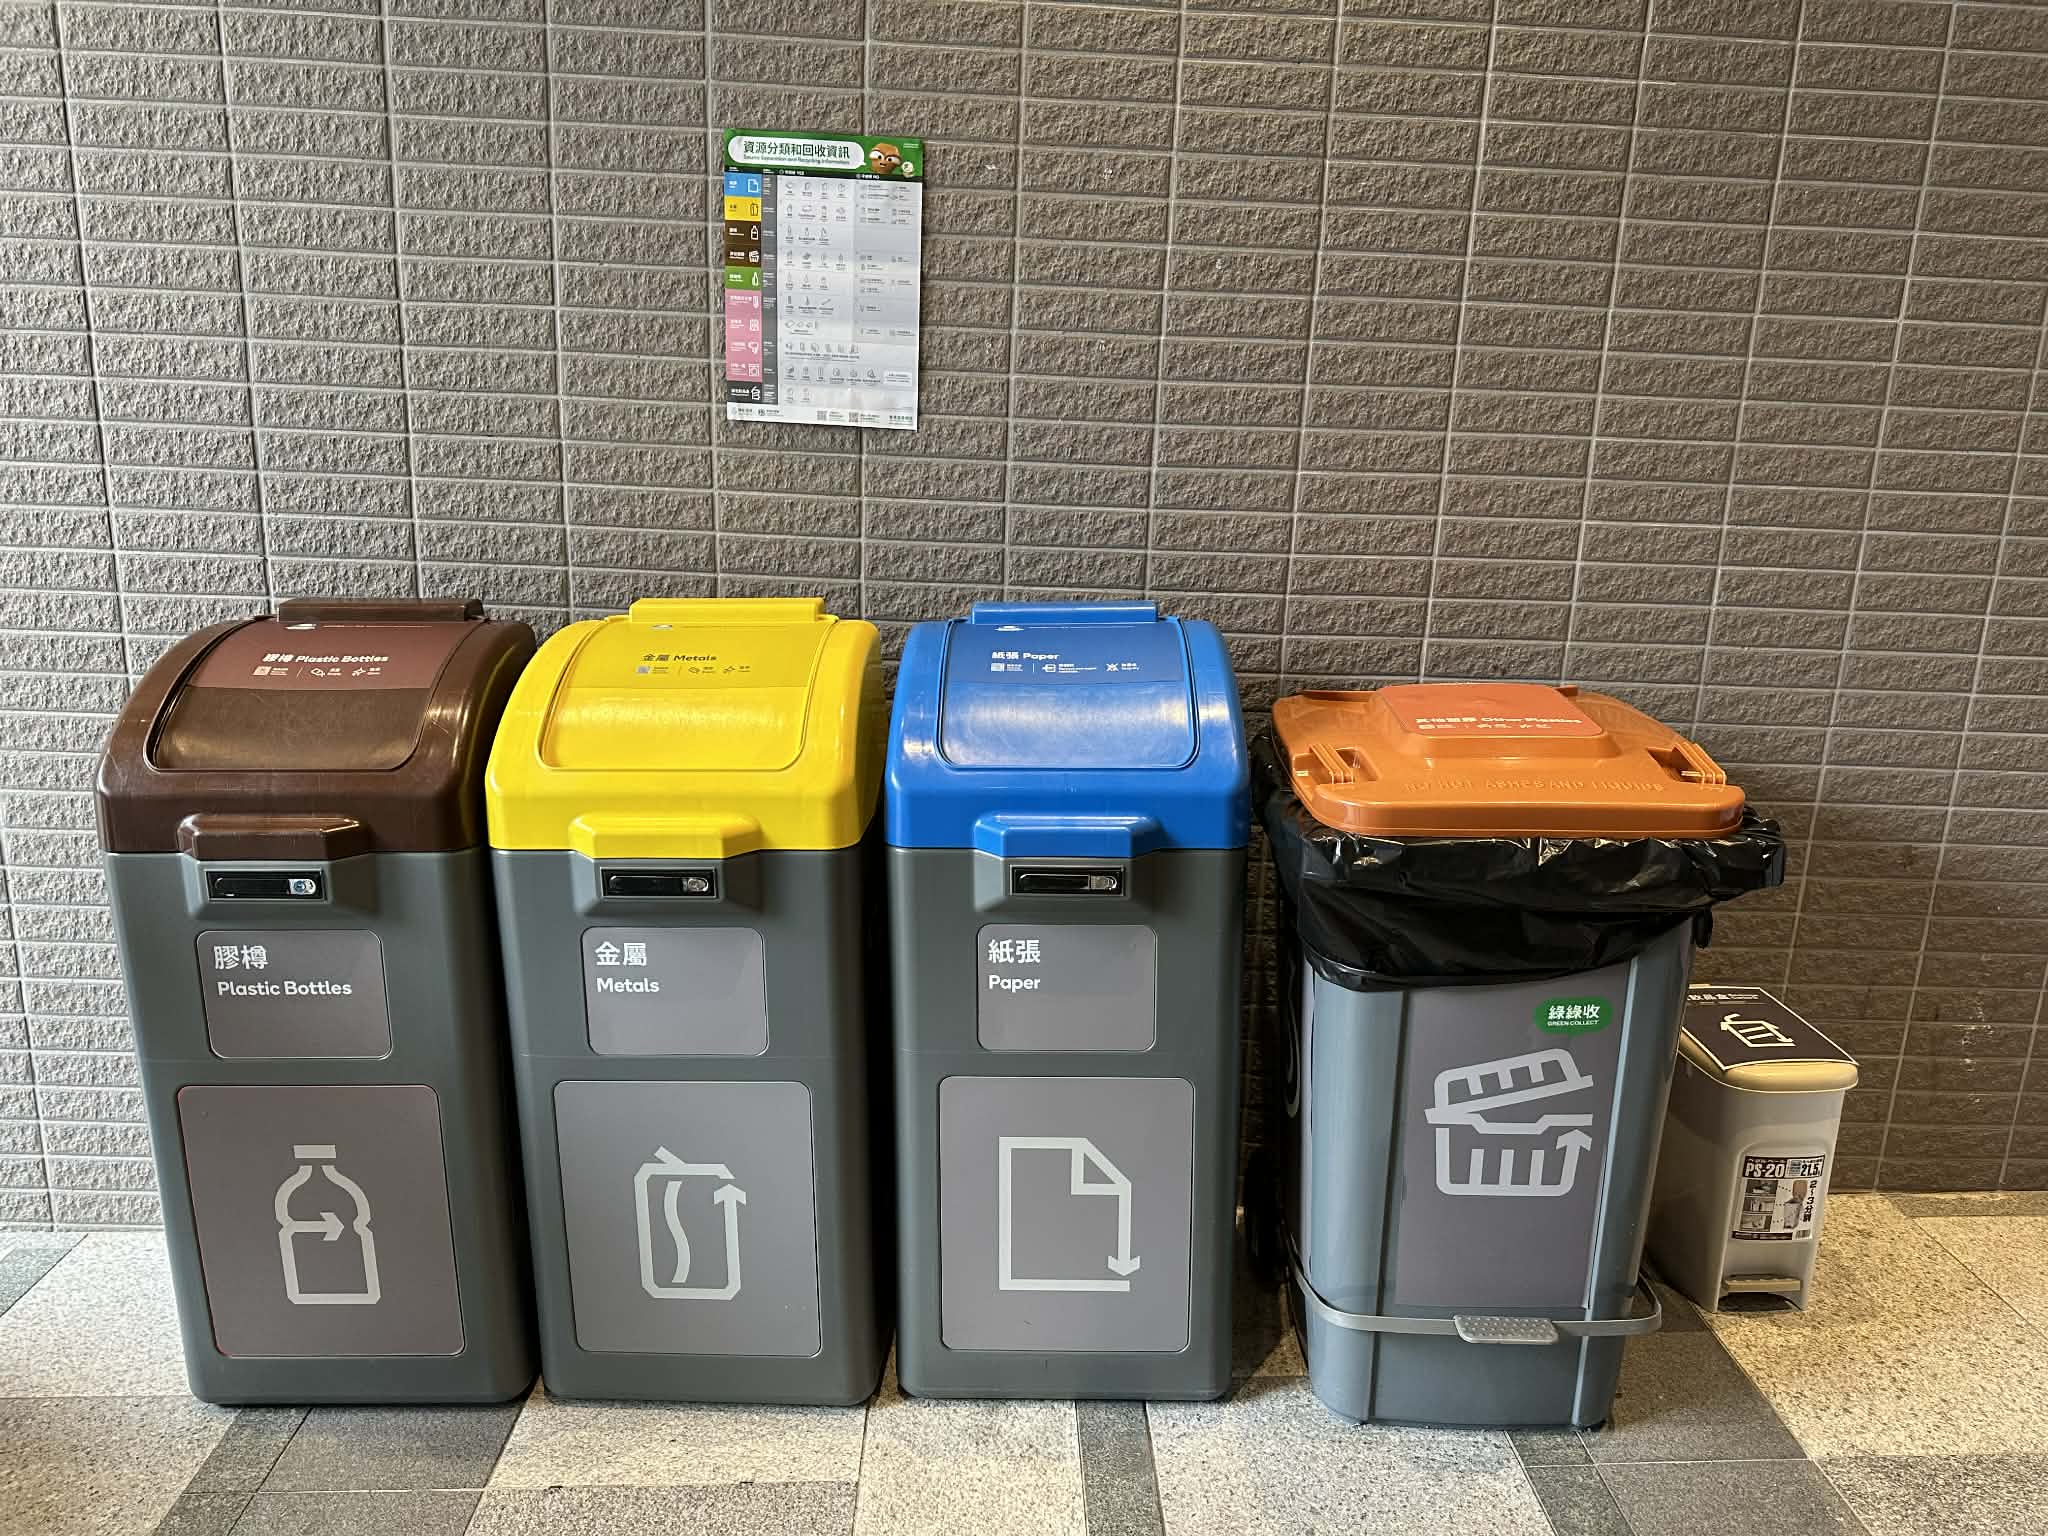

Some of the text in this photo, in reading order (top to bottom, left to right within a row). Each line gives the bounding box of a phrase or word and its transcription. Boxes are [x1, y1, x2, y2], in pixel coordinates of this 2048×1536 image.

[744, 141, 850, 159] 資源分類和回收資訊
[295, 655, 339, 663] Plastic
[340, 655, 389, 663] Bottles
[673, 654, 717, 662] Metals
[1022, 653, 1059, 661] Paper
[213, 944, 269, 970] 膠樽
[594, 941, 647, 967] 金屬
[988, 938, 1041, 964] 紙張
[217, 980, 353, 996] Plastic Bottles
[596, 977, 660, 993] Metals
[988, 974, 1041, 993] Paper
[1548, 1004, 1601, 1020] 綠綠收
[1744, 1162, 1785, 1178] PS-20
